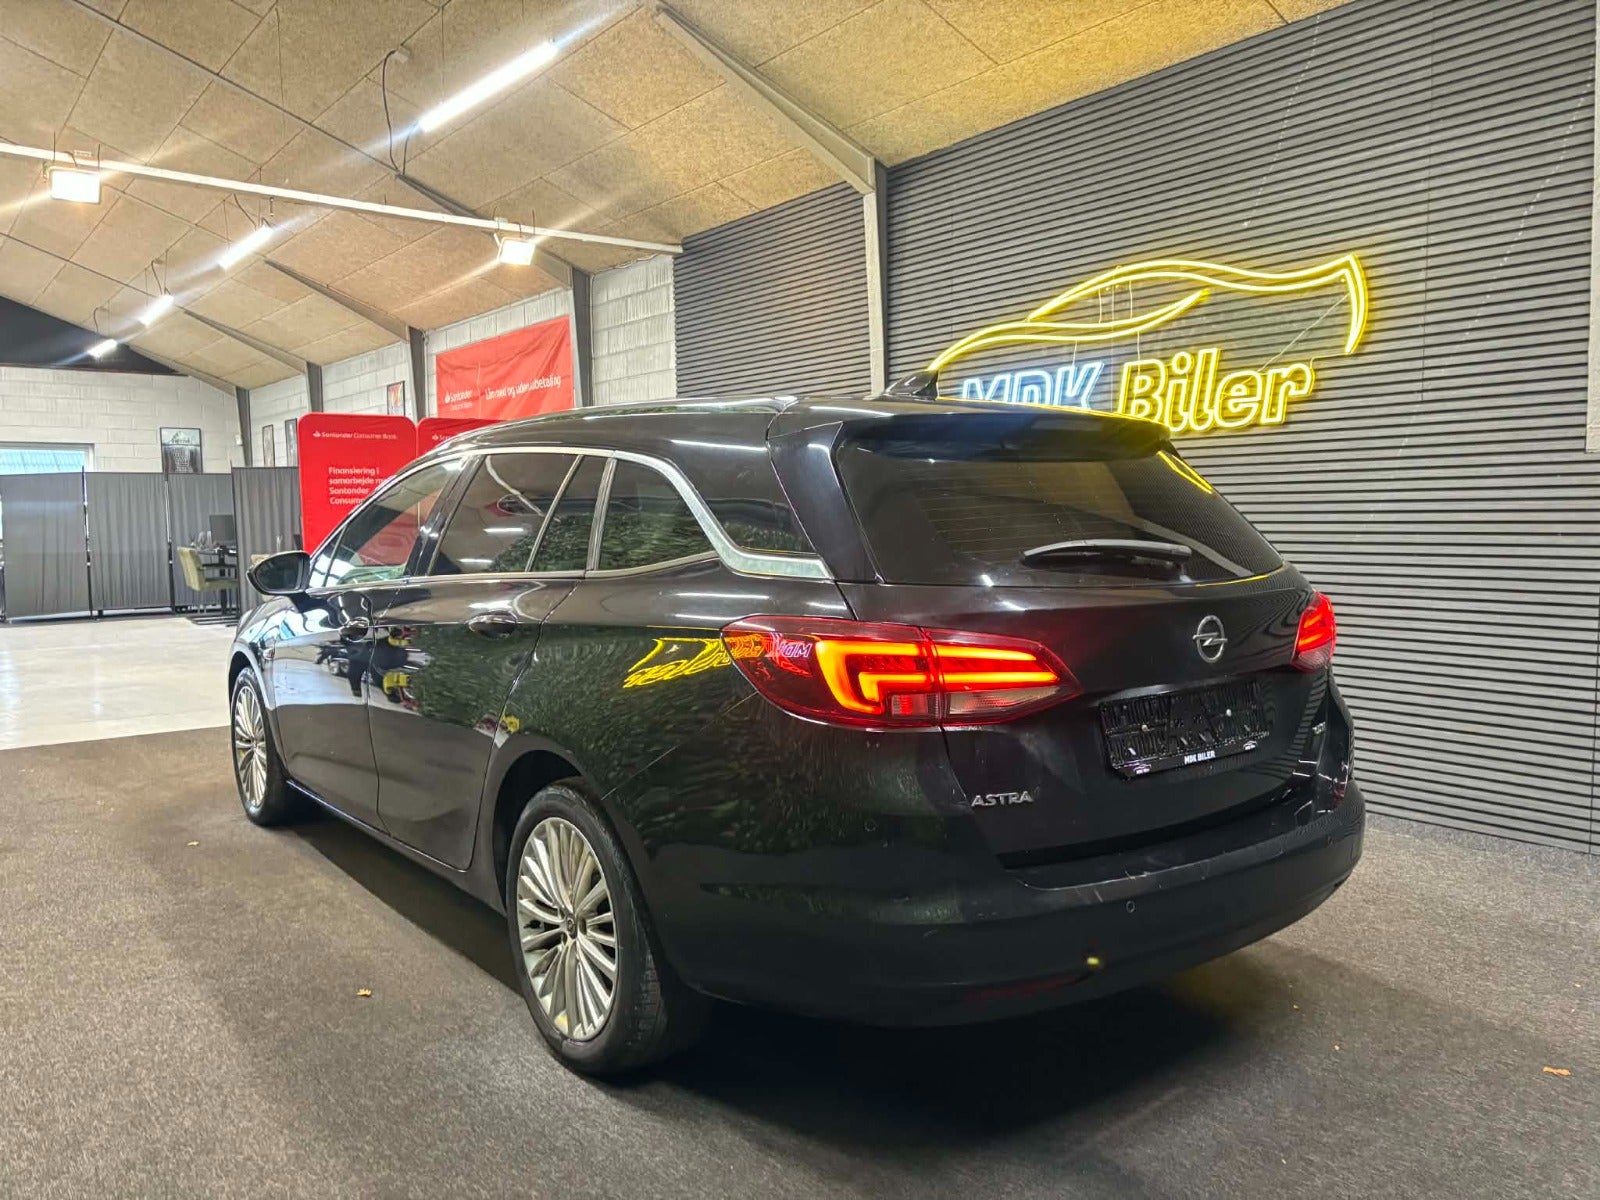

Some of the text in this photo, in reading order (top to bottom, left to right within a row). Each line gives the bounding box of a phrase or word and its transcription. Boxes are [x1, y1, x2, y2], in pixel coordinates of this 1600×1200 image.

[1119, 347, 1316, 434] Biler
[321, 431, 352, 439] Santander
[328, 466, 376, 476] Finansiering
[329, 477, 375, 485] samarbejde
[329, 487, 369, 495] Santander
[1197, 750, 1216, 762] BILER
[971, 790, 1034, 807] ASTRA
